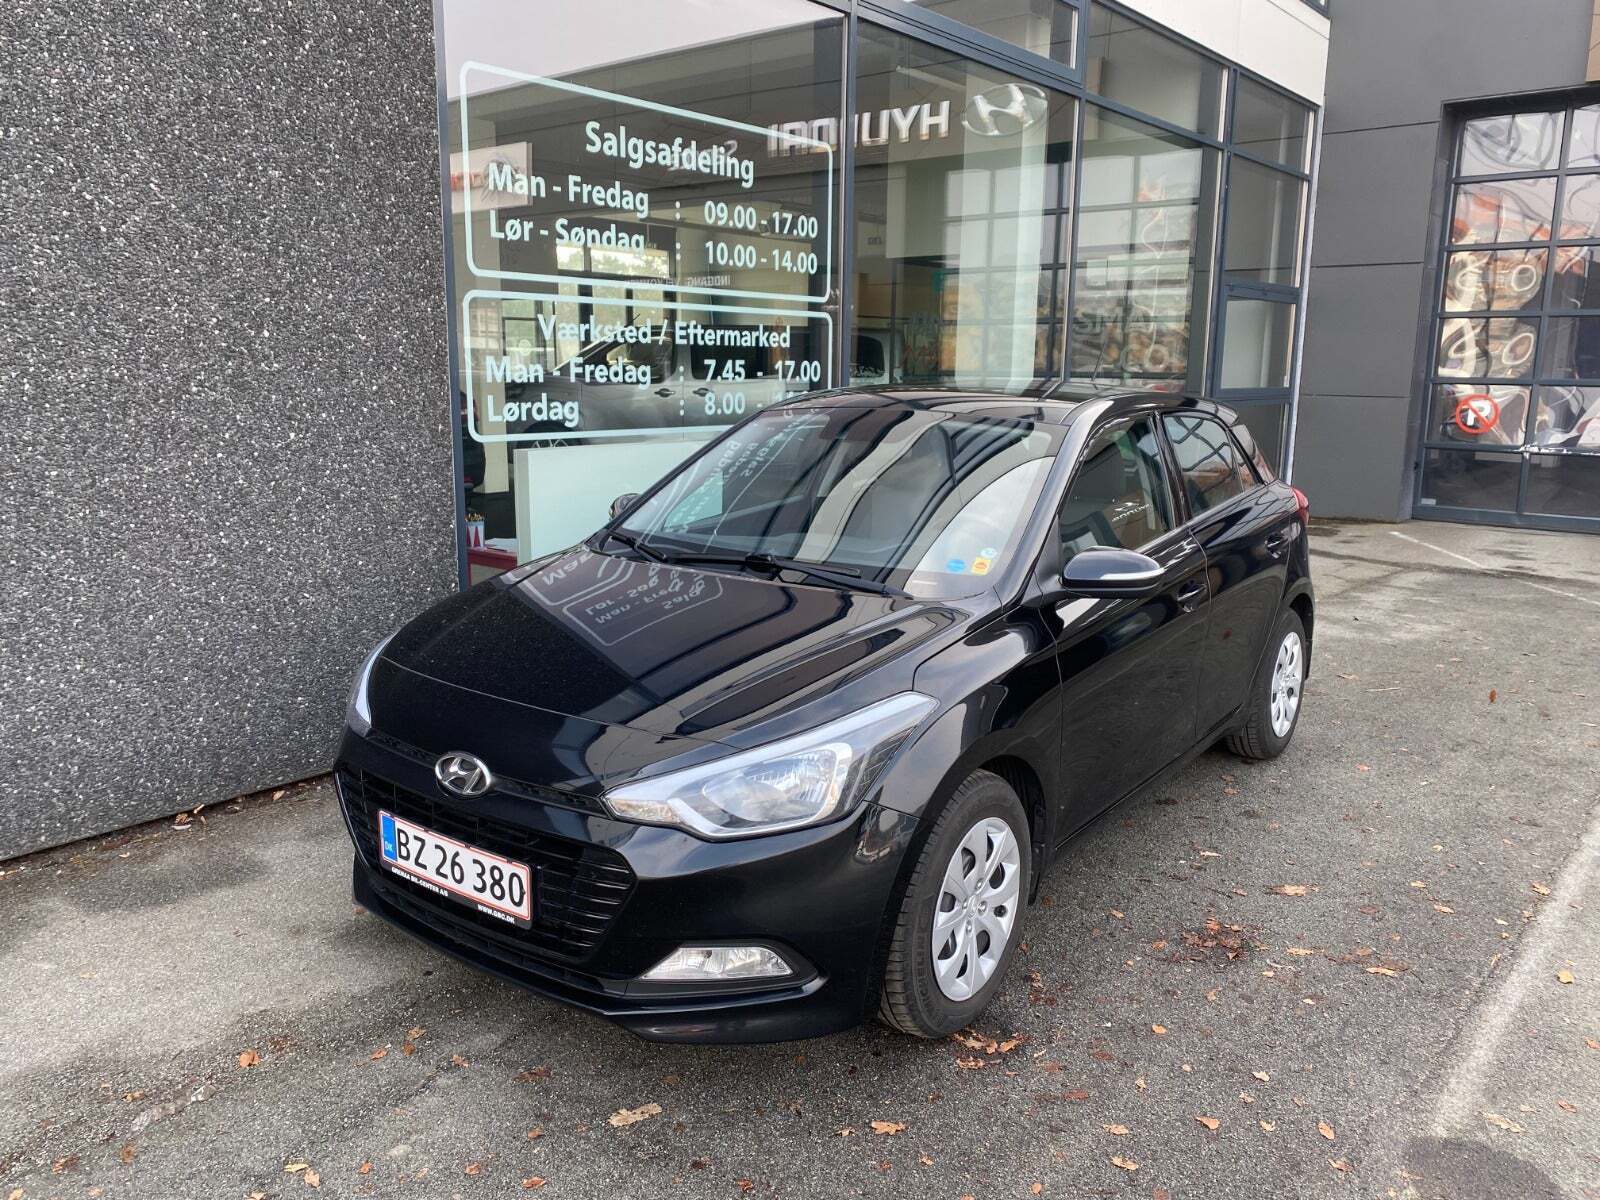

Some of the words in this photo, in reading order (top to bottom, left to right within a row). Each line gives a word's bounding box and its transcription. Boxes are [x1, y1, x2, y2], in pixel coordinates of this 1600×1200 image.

[585, 121, 754, 188] Salgsafdeling
[488, 163, 546, 198] Man
[568, 175, 649, 219] Fredag
[704, 200, 757, 230] 09.00
[772, 211, 818, 239] 17.00
[490, 209, 533, 241] Lør
[556, 219, 645, 257] Søndag
[705, 241, 756, 268] 10.00
[772, 249, 818, 275] 14.00
[537, 314, 651, 344] Værksted
[675, 320, 791, 348] Eftermarked
[486, 355, 544, 384] Man
[569, 356, 651, 388] Fredag
[704, 359, 745, 383] 7.45
[774, 359, 821, 383] 17.00
[488, 393, 579, 427] Lørdag
[704, 393, 745, 415] 8.00
[397, 828, 428, 870] BZ
[435, 844, 464, 885] 26
[472, 858, 525, 908] 380
